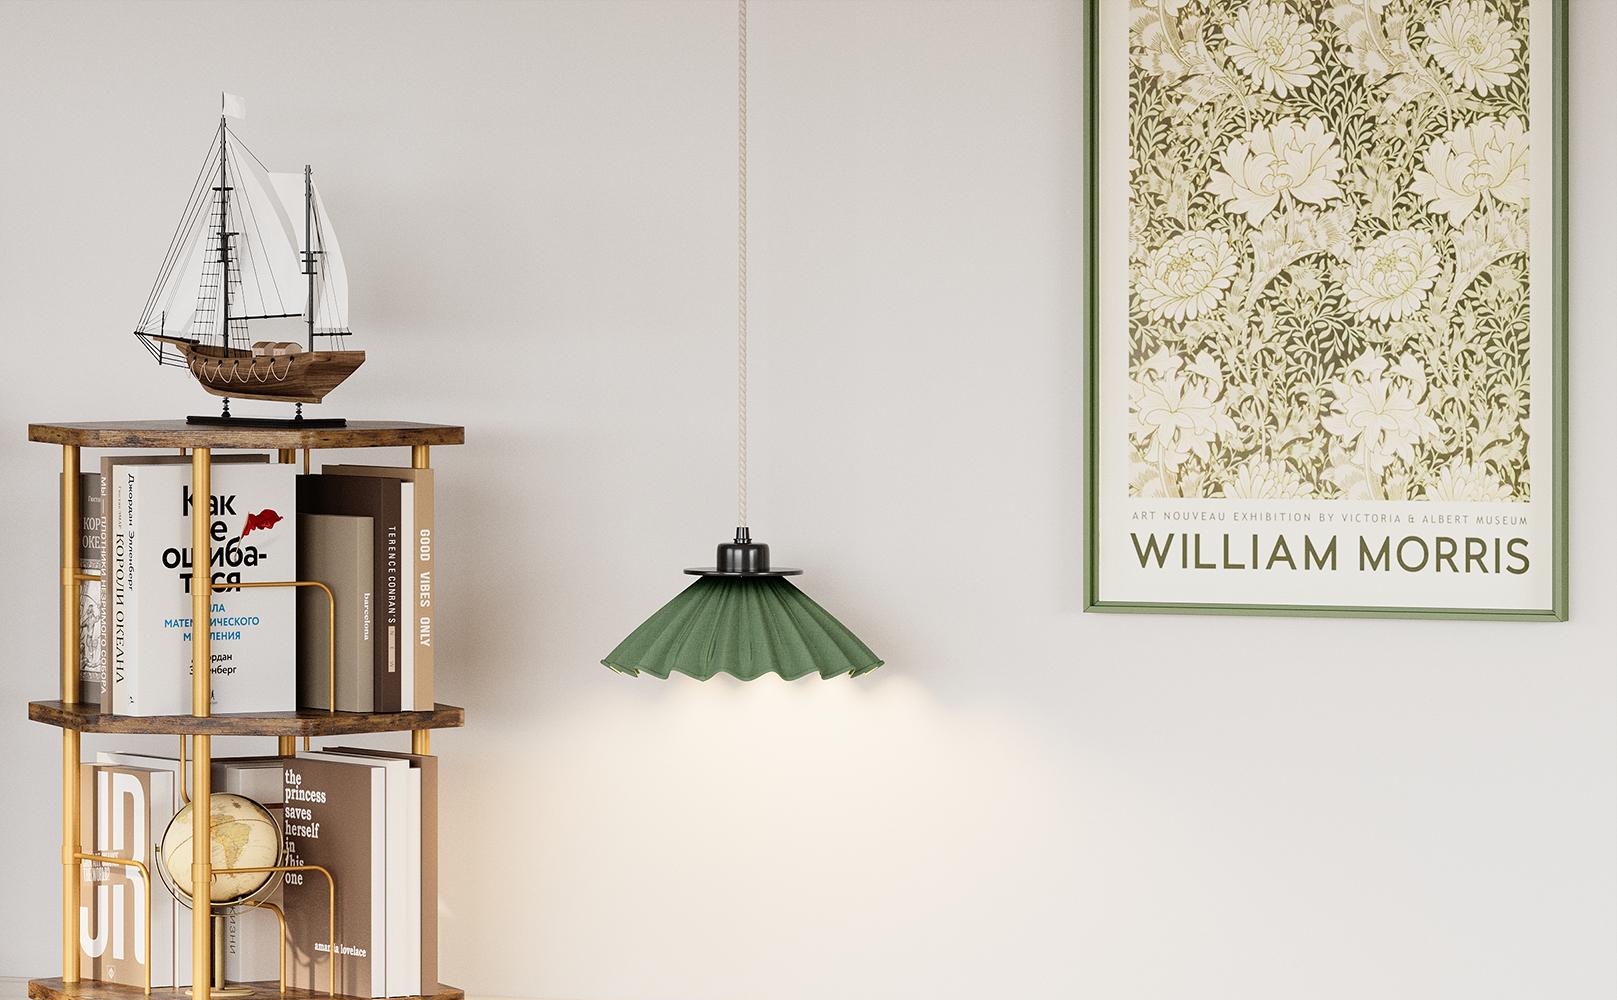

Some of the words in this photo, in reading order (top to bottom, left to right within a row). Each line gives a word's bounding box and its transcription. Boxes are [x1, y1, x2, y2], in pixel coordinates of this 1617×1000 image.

[100, 477, 107, 497] МЫ
[127, 473, 135, 526] Джордан
[83, 517, 101, 530] КОР
[1132, 511, 1155, 520] ART
[1164, 512, 1225, 521] NOUVEAU
[1234, 512, 1311, 522] EXHIBITION
[1319, 513, 1334, 523] BY
[1341, 514, 1401, 524] VICTORIA
[1408, 514, 1415, 524] &
[1422, 515, 1469, 524] ALBERT
[1476, 516, 1528, 526] MUSEUM
[210, 520, 228, 541] е
[82, 536, 101, 549] ОКЕ
[388, 526, 396, 573] TERENCE
[420, 529, 430, 561] GOOD
[127, 530, 135, 590] Элленберг
[1130, 532, 1337, 571] WILLIAM
[1359, 535, 1530, 575] MORRIS
[116, 534, 124, 607] КОРОЛИ
[179, 572, 241, 594] тся
[420, 571, 430, 608] VIBES
[210, 603, 226, 613] ЛА
[388, 576, 396, 624] CONRAN'S
[164, 616, 260, 628] МАТЕИЧЕСКОГО
[183, 631, 241, 641] МЛЕНИЯ
[420, 617, 430, 647] ONLY
[116, 610, 124, 684] ОКЕАНА
[191, 654, 233, 663] рдан
[189, 665, 237, 676] нберг
[285, 769, 302, 786] the
[285, 785, 327, 804] princess
[285, 805, 312, 821] saves
[285, 820, 320, 839] herself
[285, 837, 296, 853] in
[285, 872, 304, 886] one
[314, 942, 339, 954] amana
[340, 943, 367, 957] lovelace
